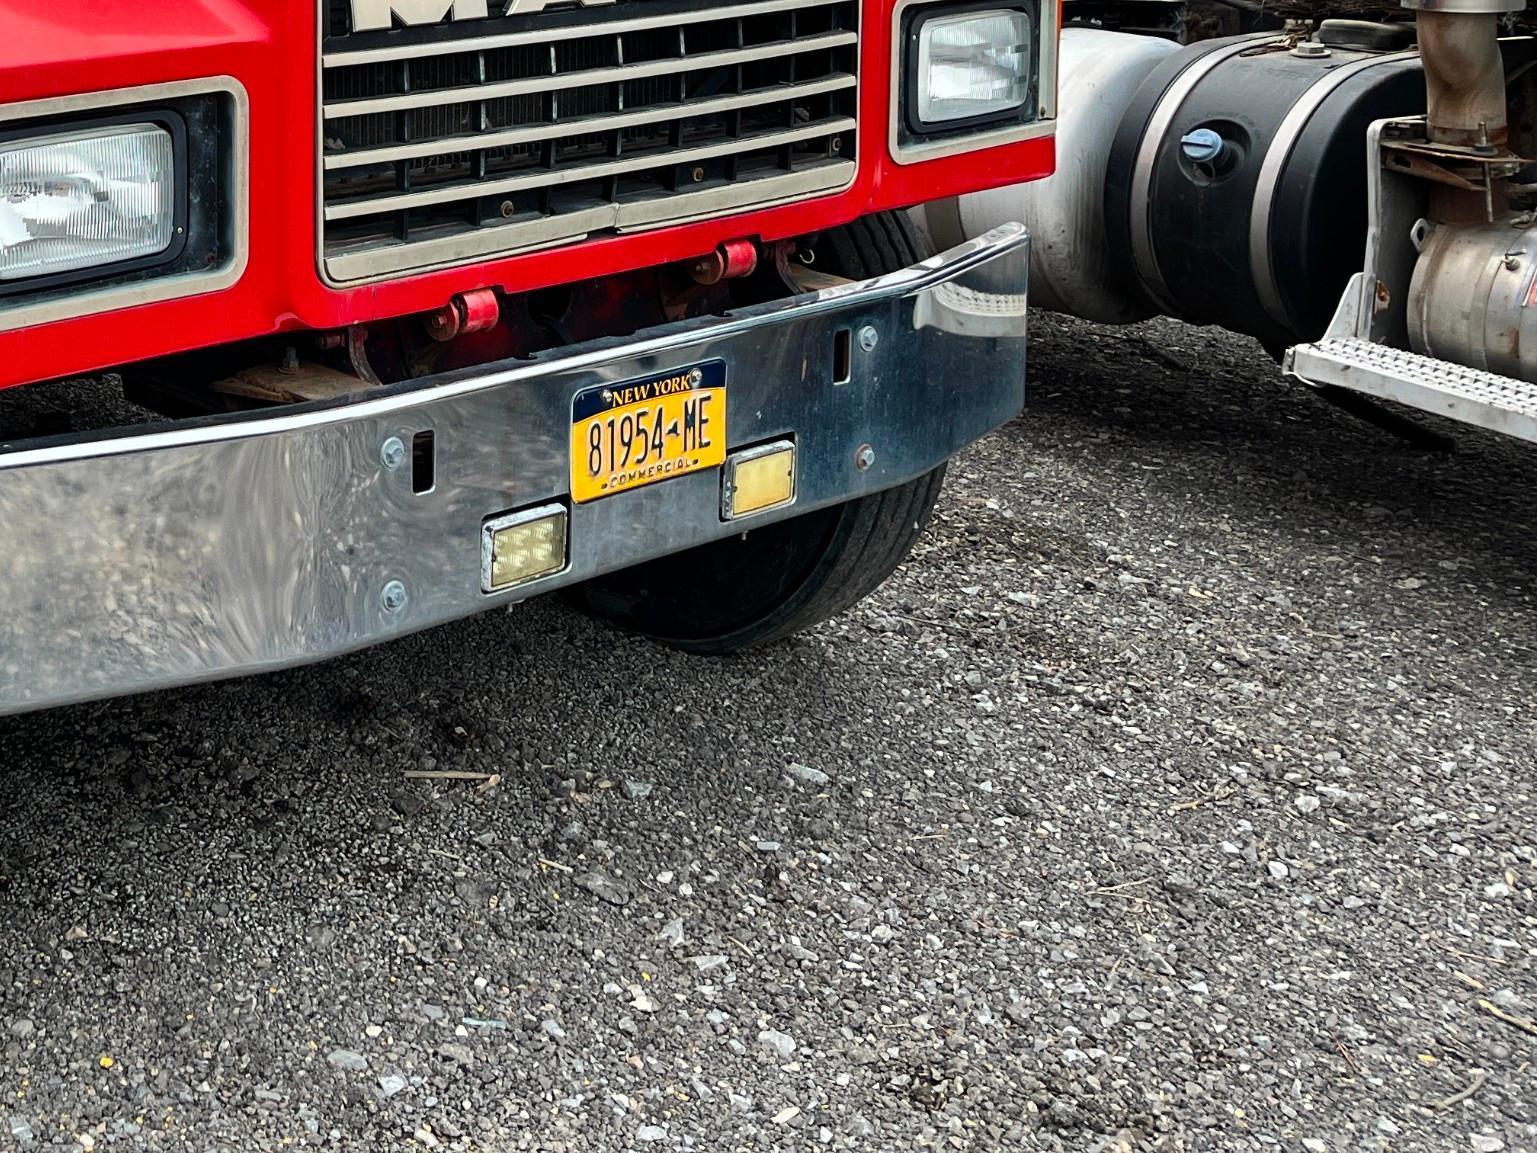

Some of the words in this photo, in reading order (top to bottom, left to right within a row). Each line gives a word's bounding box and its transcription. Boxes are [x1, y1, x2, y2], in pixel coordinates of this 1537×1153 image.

[612, 385, 650, 408] NEW
[653, 376, 691, 396] YORK
[609, 459, 693, 488] COMMERCIAL
